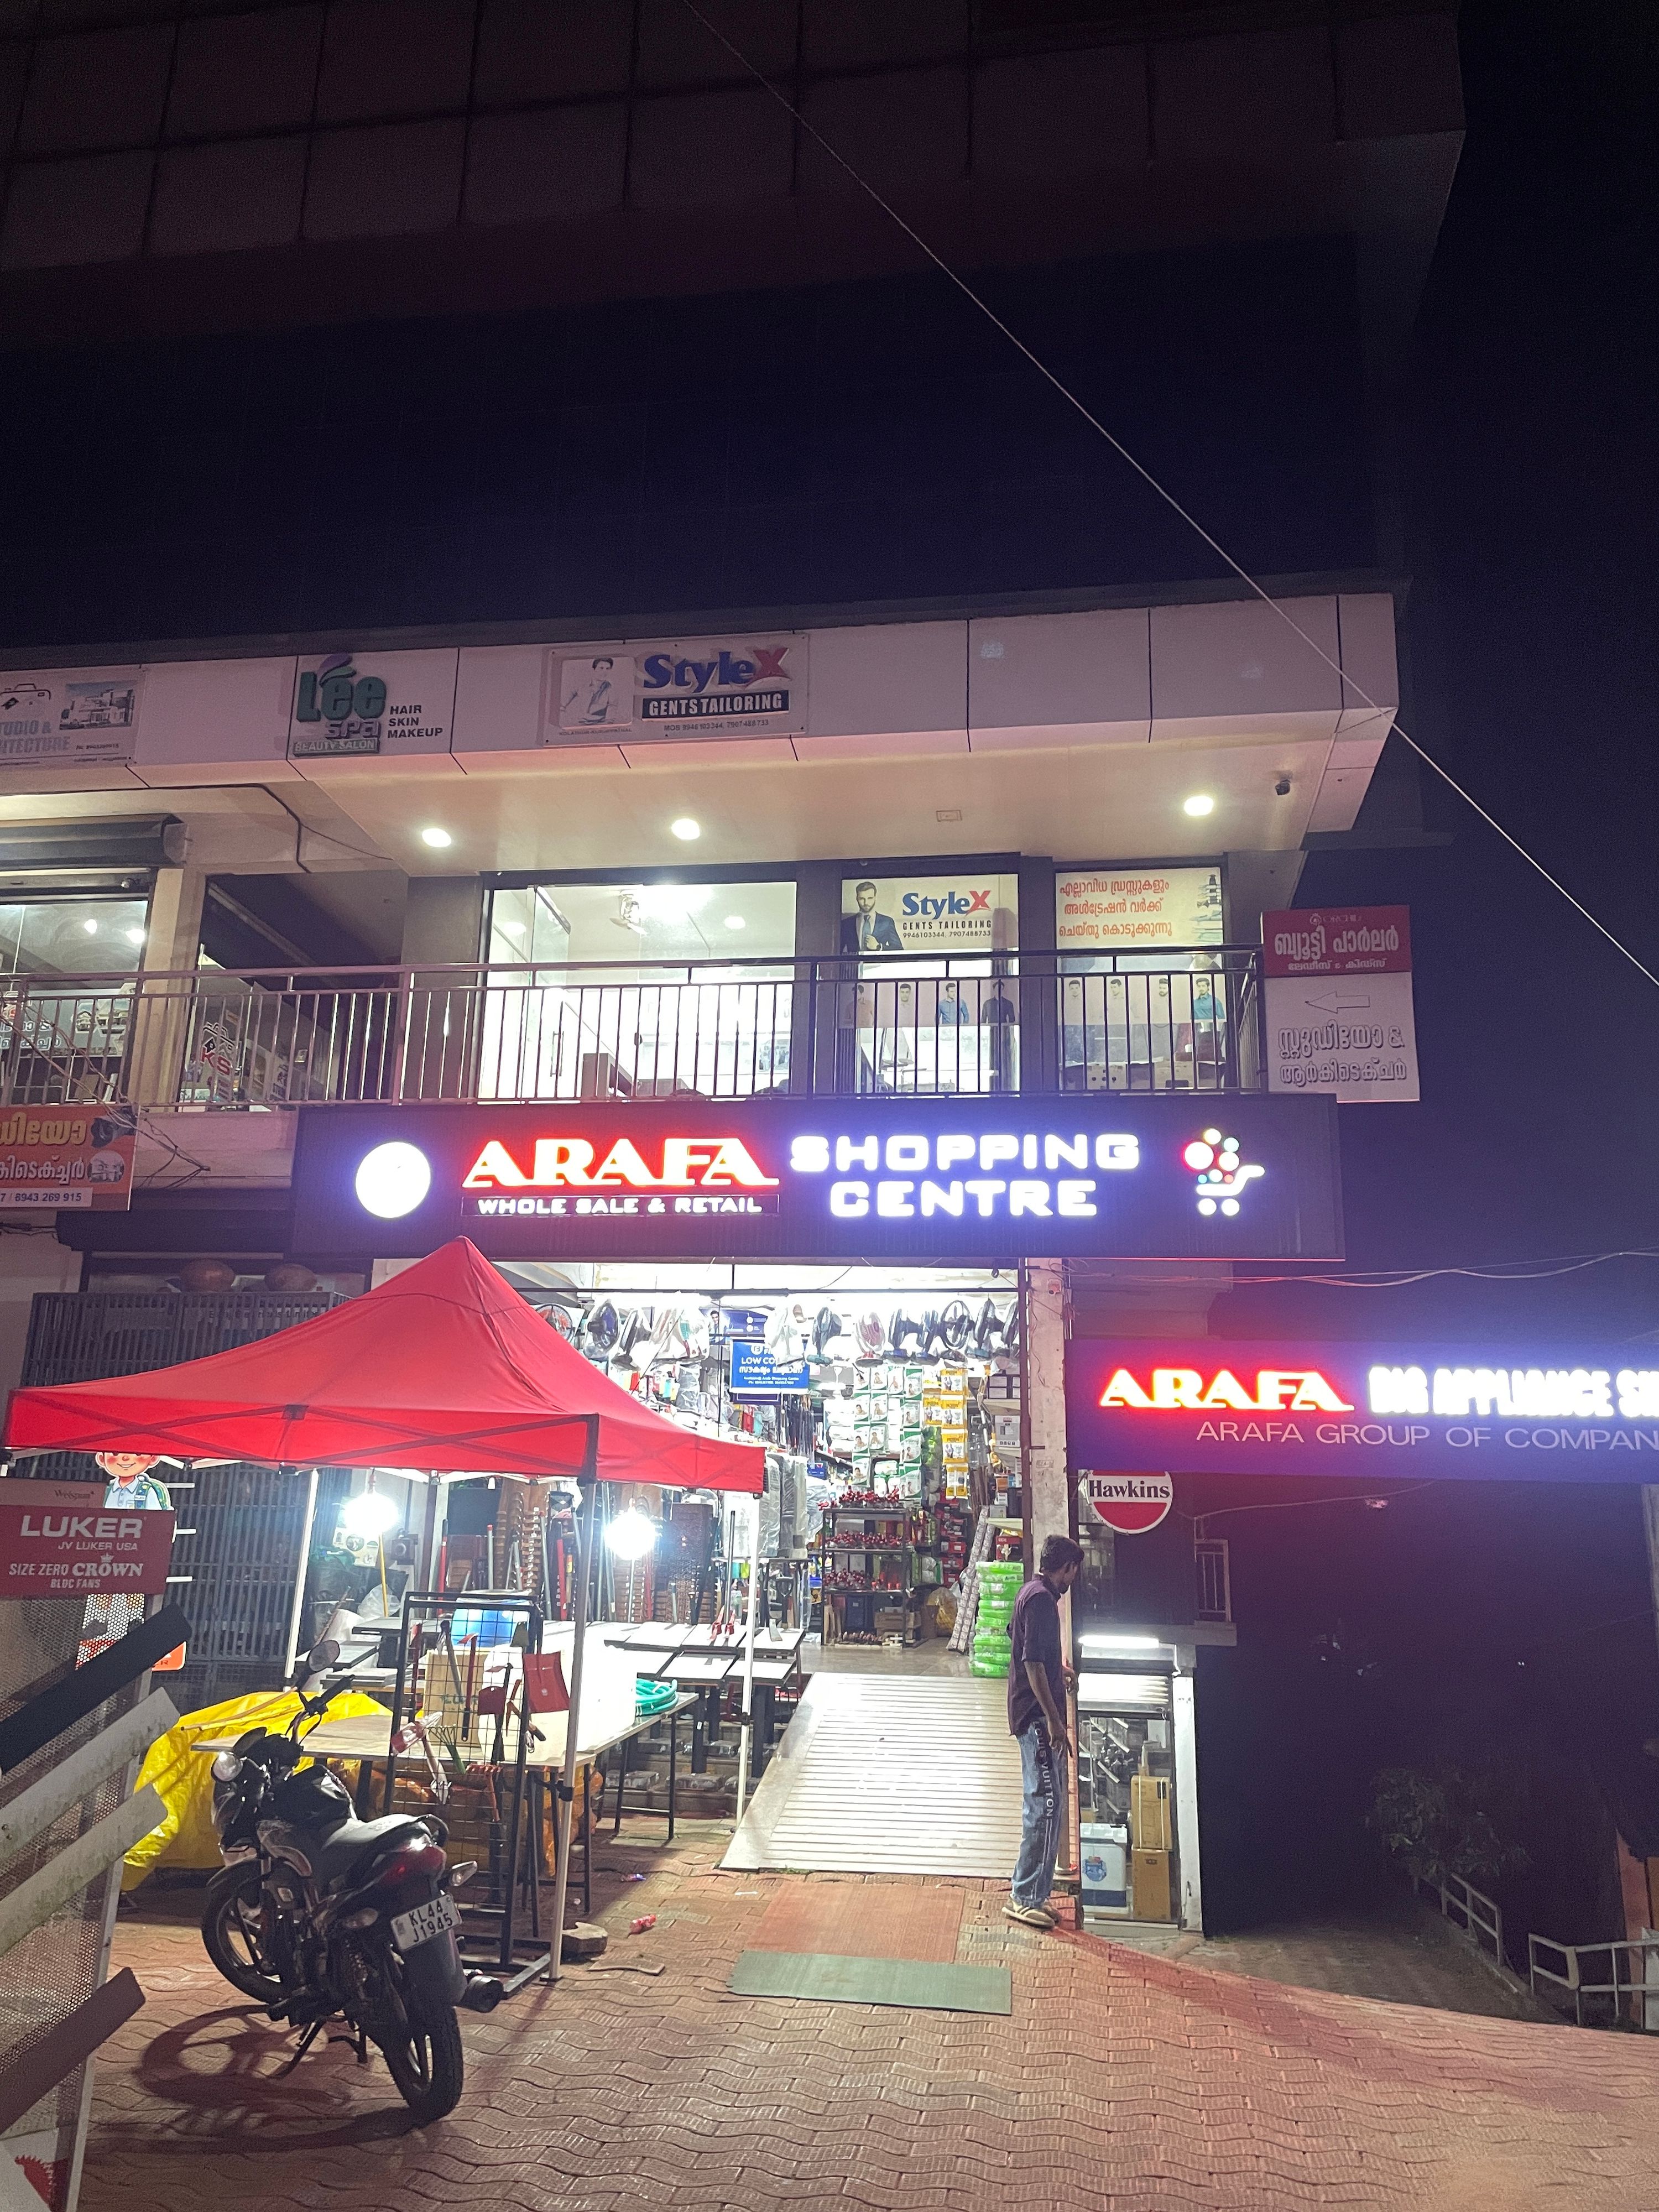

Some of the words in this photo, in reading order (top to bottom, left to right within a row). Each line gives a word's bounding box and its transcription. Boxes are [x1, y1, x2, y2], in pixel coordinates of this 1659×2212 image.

[644, 648, 791, 693] StyleX
[389, 705, 422, 715] HAIR
[649, 698, 698, 716] GENTS
[700, 693, 782, 713] TAILORING
[387, 727, 443, 739] MAKEUP
[388, 717, 419, 727] SKIN
[295, 741, 337, 752] BEAUTY
[339, 739, 374, 749] SALON
[902, 890, 992, 920] StyleX
[902, 921, 933, 930] GENTS
[938, 920, 992, 930] TAILORING
[1333, 924, 1399, 953] പാർലർ
[1387, 1025, 1405, 1048] &
[462, 1138, 780, 1188] ARAFA
[790, 1134, 1140, 1172] SHOPPING
[63, 1193, 81, 1201] 915
[477, 1198, 567, 1215] WHOLE
[574, 1198, 640, 1214] SALE
[647, 1198, 666, 1214] &
[674, 1197, 763, 1213] RETAIL
[830, 1180, 1097, 1217] CENTRE
[1099, 1369, 1355, 1412] ARAFA
[1196, 1421, 1305, 1444] ARAFA
[1316, 1424, 1431, 1447] GROUP
[1446, 1427, 1492, 1448] OF
[1088, 1480, 1171, 1499] Hawkins
[20, 1515, 143, 1539] LUKER
[76, 1542, 113, 1551] LUKER
[116, 1542, 138, 1551] USA
[8, 1563, 36, 1576] SIZE
[38, 1563, 70, 1576] ZERO
[72, 1562, 144, 1577] CROWN
[1041, 1761, 1054, 1817] VUITTON
